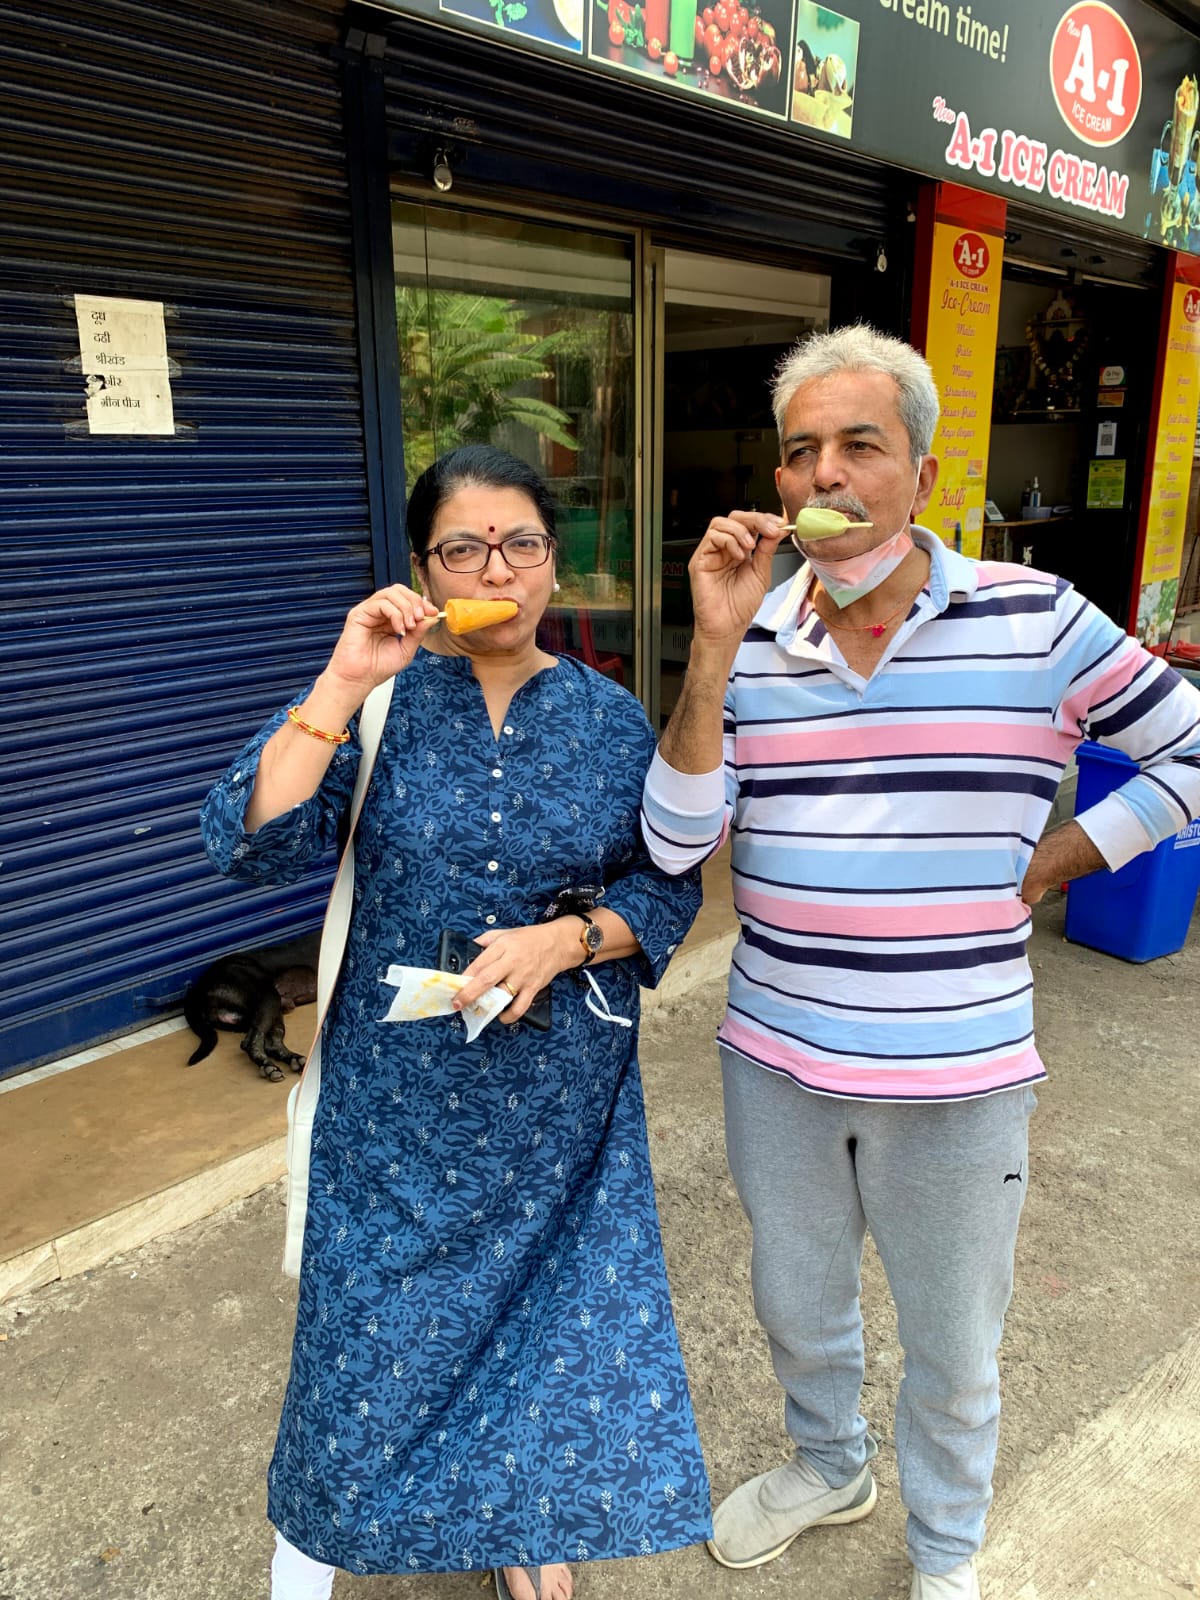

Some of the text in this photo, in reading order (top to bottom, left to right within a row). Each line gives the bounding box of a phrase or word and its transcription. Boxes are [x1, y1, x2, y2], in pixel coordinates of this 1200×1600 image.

[879, 0, 1009, 63] eam time!
[932, 95, 956, 124] New
[1072, 99, 1112, 132] ICE CREAM
[945, 112, 1129, 219] A-1 ICE CREAM
[958, 239, 985, 268] A-1
[941, 288, 991, 316] Ice-Cream
[91, 311, 106, 325] दूध
[93, 331, 111, 344] दही
[95, 354, 126, 366] श्रीखंड
[939, 488, 967, 511] Kulfi
